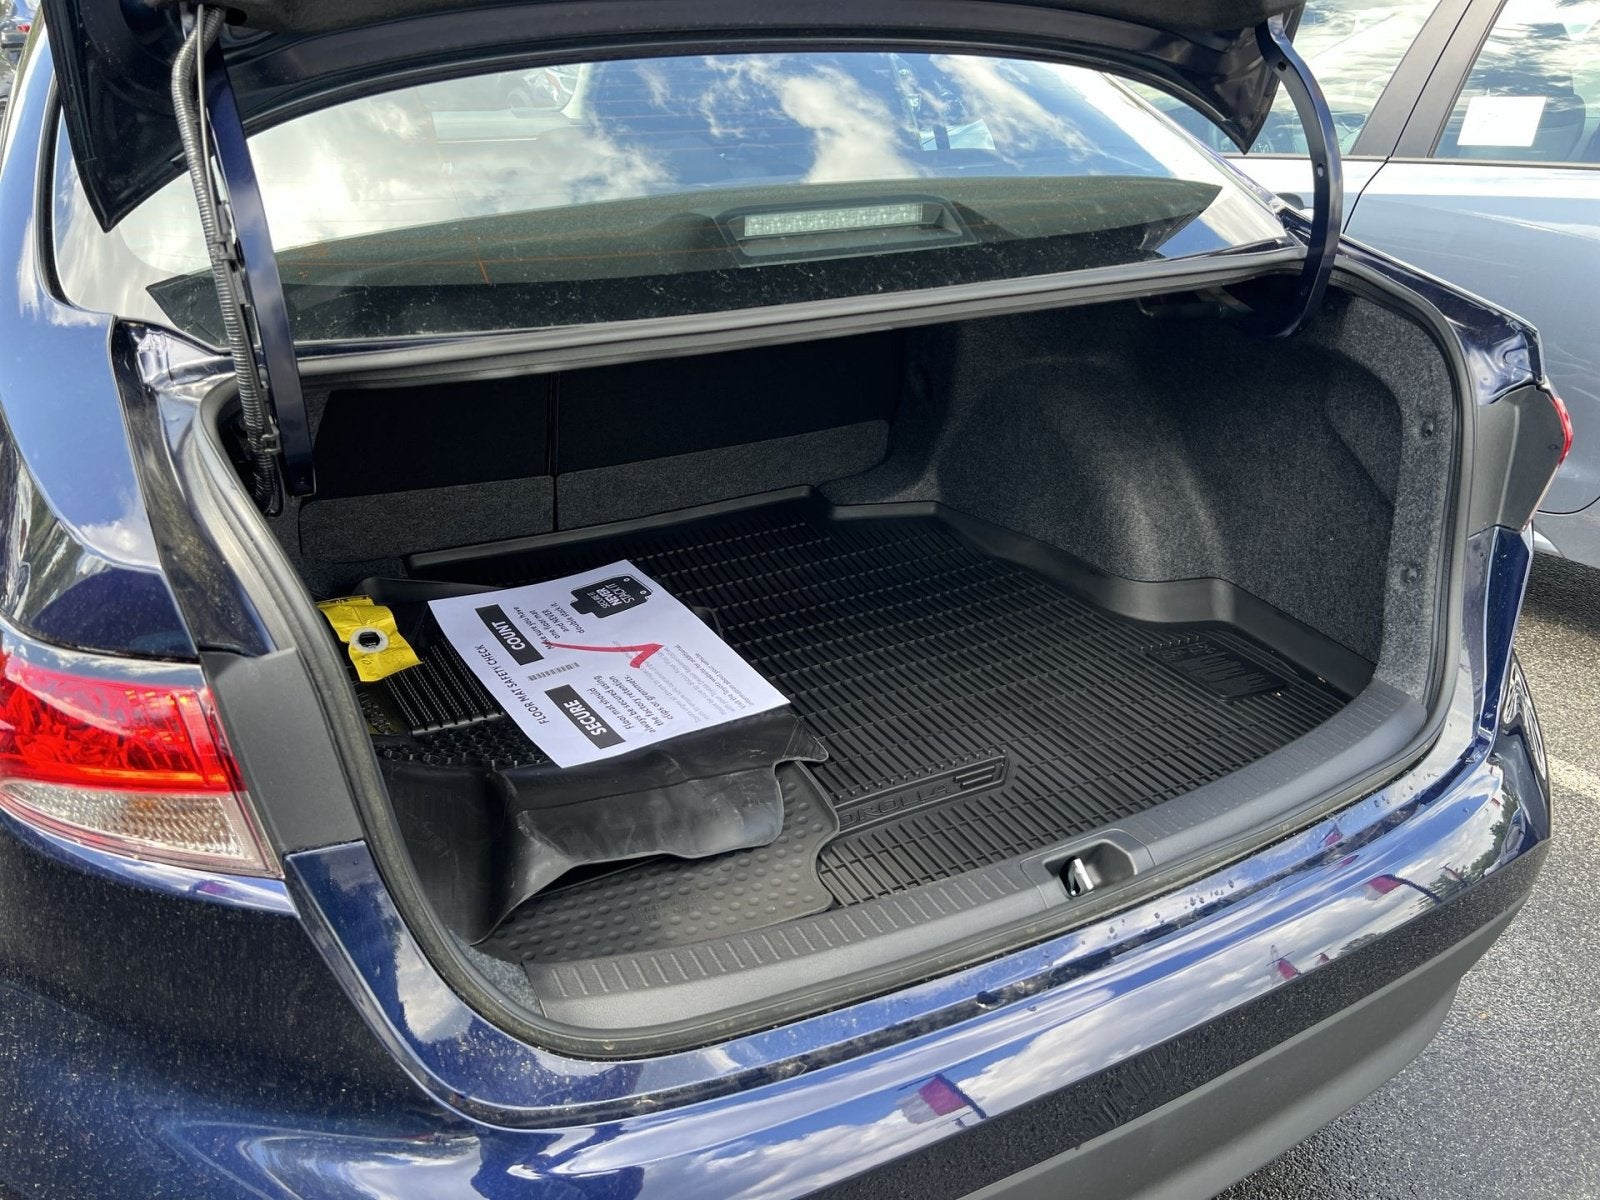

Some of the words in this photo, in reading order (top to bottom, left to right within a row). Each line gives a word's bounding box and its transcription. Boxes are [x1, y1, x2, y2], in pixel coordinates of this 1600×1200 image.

[596, 587, 621, 605] NEVER
[611, 586, 634, 603] STACK
[513, 606, 525, 618] have
[529, 609, 541, 618] mat
[541, 608, 559, 623] NEVER
[554, 606, 569, 617] stack
[522, 617, 536, 626] you
[538, 618, 551, 630] floor
[555, 622, 569, 632] and
[566, 616, 584, 633] double
[491, 621, 525, 649] COUNT
[530, 625, 543, 636] sure
[548, 629, 560, 639] one
[474, 644, 497, 665] CHECK
[491, 665, 517, 687] SAFETY
[593, 675, 610, 689] using
[609, 675, 634, 698] retention
[510, 688, 529, 701] MAT
[586, 687, 609, 704] should
[604, 689, 630, 708] secured
[524, 701, 549, 724] FLOOR
[605, 704, 620, 715] mat
[626, 707, 637, 716] be
[632, 698, 654, 716] factory
[656, 707, 673, 719] clips
[564, 699, 606, 735] SECURE
[616, 714, 634, 729] Floor
[634, 714, 656, 732] always
[651, 716, 663, 726] the
[839, 784, 950, 827] OROLLA
